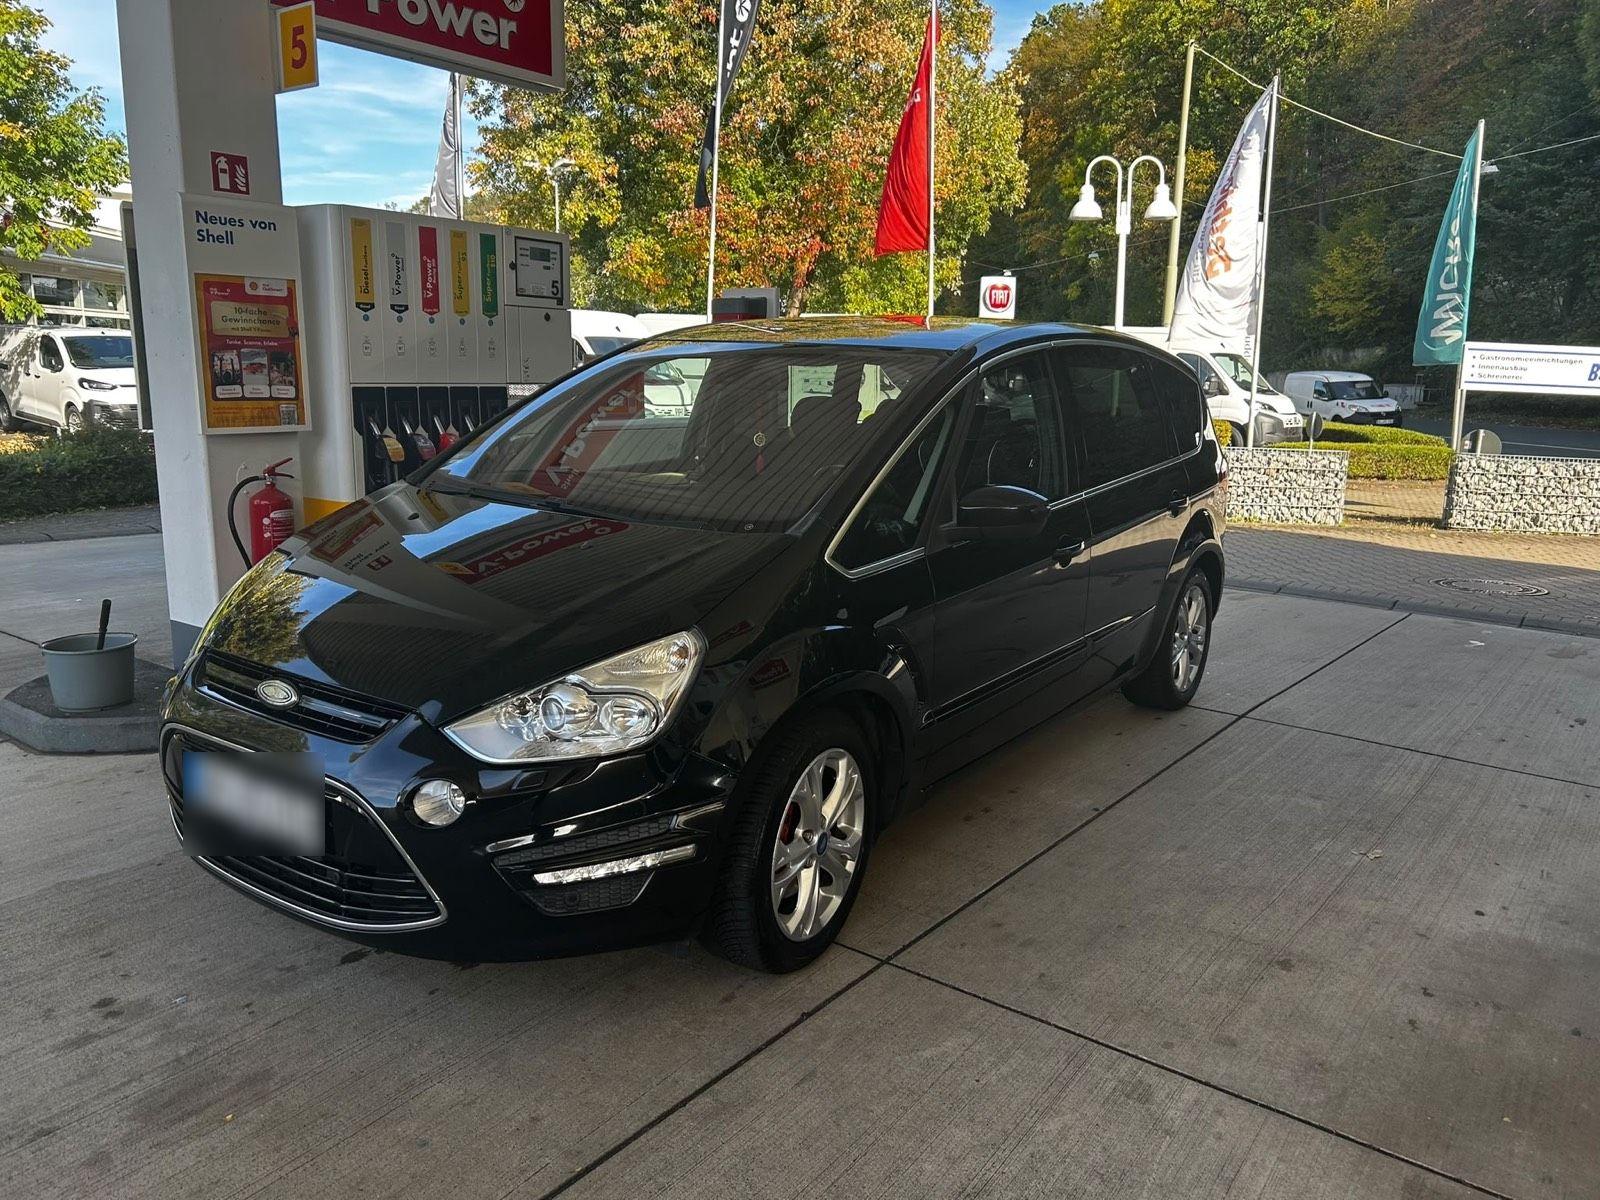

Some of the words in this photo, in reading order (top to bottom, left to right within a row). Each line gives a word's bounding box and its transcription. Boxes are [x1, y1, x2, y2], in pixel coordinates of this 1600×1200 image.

[291, 25, 308, 70] 5
[195, 210, 244, 228] Neues
[250, 219, 277, 232] von
[197, 229, 234, 245] Shell
[362, 268, 370, 294] Diesel
[394, 254, 402, 295] V-Power
[456, 272, 464, 300] Super
[485, 277, 493, 303] Super
[551, 280, 559, 296] 5
[991, 289, 1009, 305] FIAT
[221, 315, 281, 325] Gewinnchance
[234, 307, 268, 316] 10-fache
[1478, 364, 1528, 372] Innenausbau
